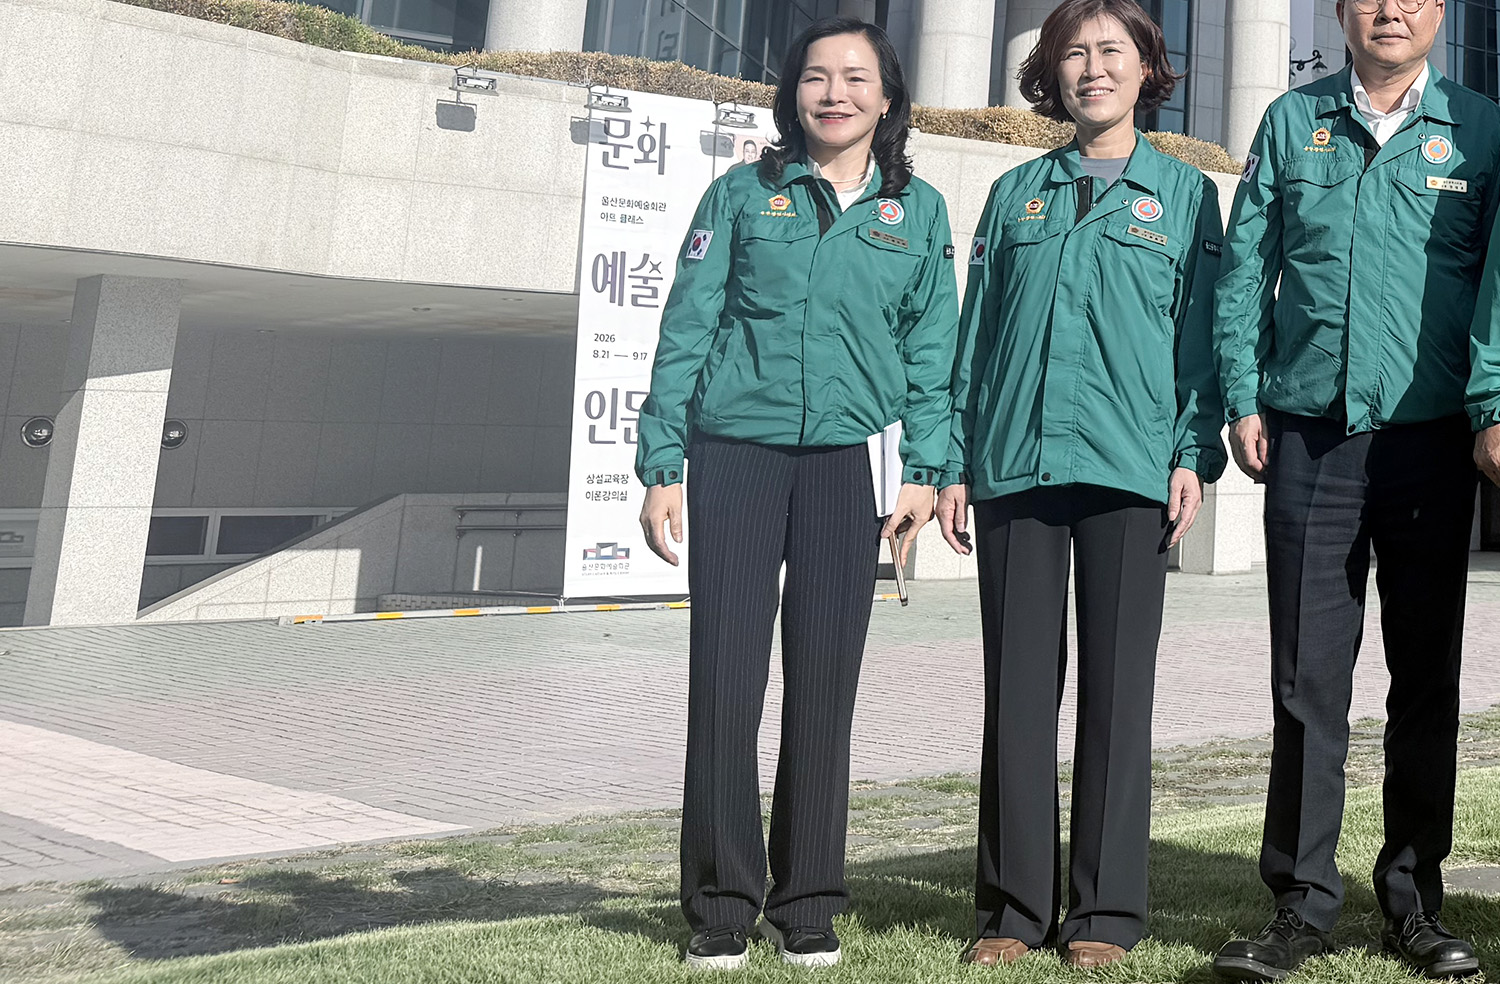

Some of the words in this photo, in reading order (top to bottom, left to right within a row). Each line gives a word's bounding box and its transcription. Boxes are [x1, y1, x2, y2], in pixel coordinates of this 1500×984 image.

[599, 116, 671, 175] 문화
[601, 196, 667, 212] 울산문화예술회관
[591, 251, 664, 308] 예술
[593, 333, 616, 343] 2026
[592, 349, 610, 359] 8.21
[632, 351, 648, 361] 9.17
[584, 387, 650, 444] 인문
[586, 473, 629, 484] 상설교육장
[585, 490, 628, 502] 이론강의실
